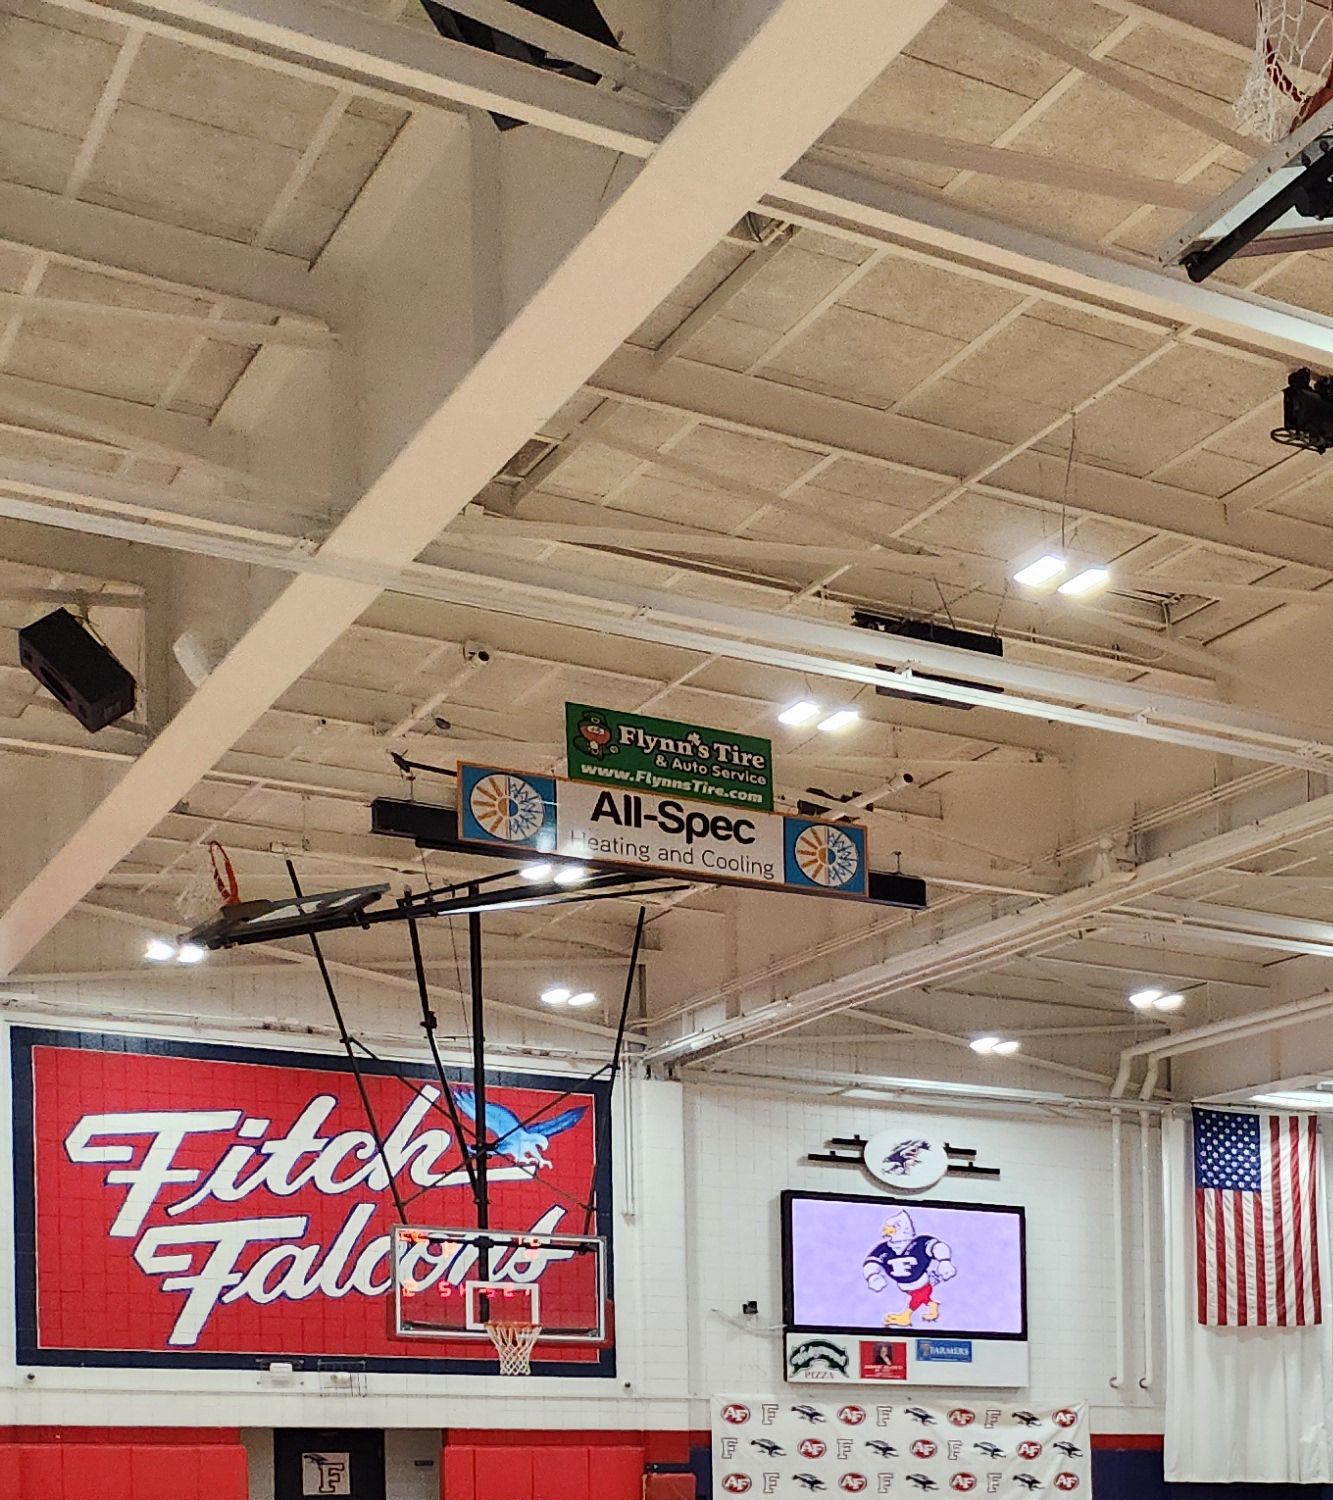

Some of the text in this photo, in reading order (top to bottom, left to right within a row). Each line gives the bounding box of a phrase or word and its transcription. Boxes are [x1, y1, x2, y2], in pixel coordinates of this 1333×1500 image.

[618, 725, 766, 769] Flynn's Tire
[581, 764, 763, 803] www.FlynnsTire.com
[656, 755, 767, 785] & Auto Service
[590, 791, 756, 845] All-Spec
[570, 830, 774, 880] Heating and Cooling
[64, 1083, 537, 1238] Fitch
[133, 1202, 577, 1346] Falcons
[886, 1255, 918, 1278] F
[723, 1404, 1077, 1429] AF F AF F AF F AF
[721, 1437, 1041, 1460] F AF F AF F AF
[318, 1462, 345, 1494] F
[724, 1472, 1078, 1494] AF F AF F AF F AF
